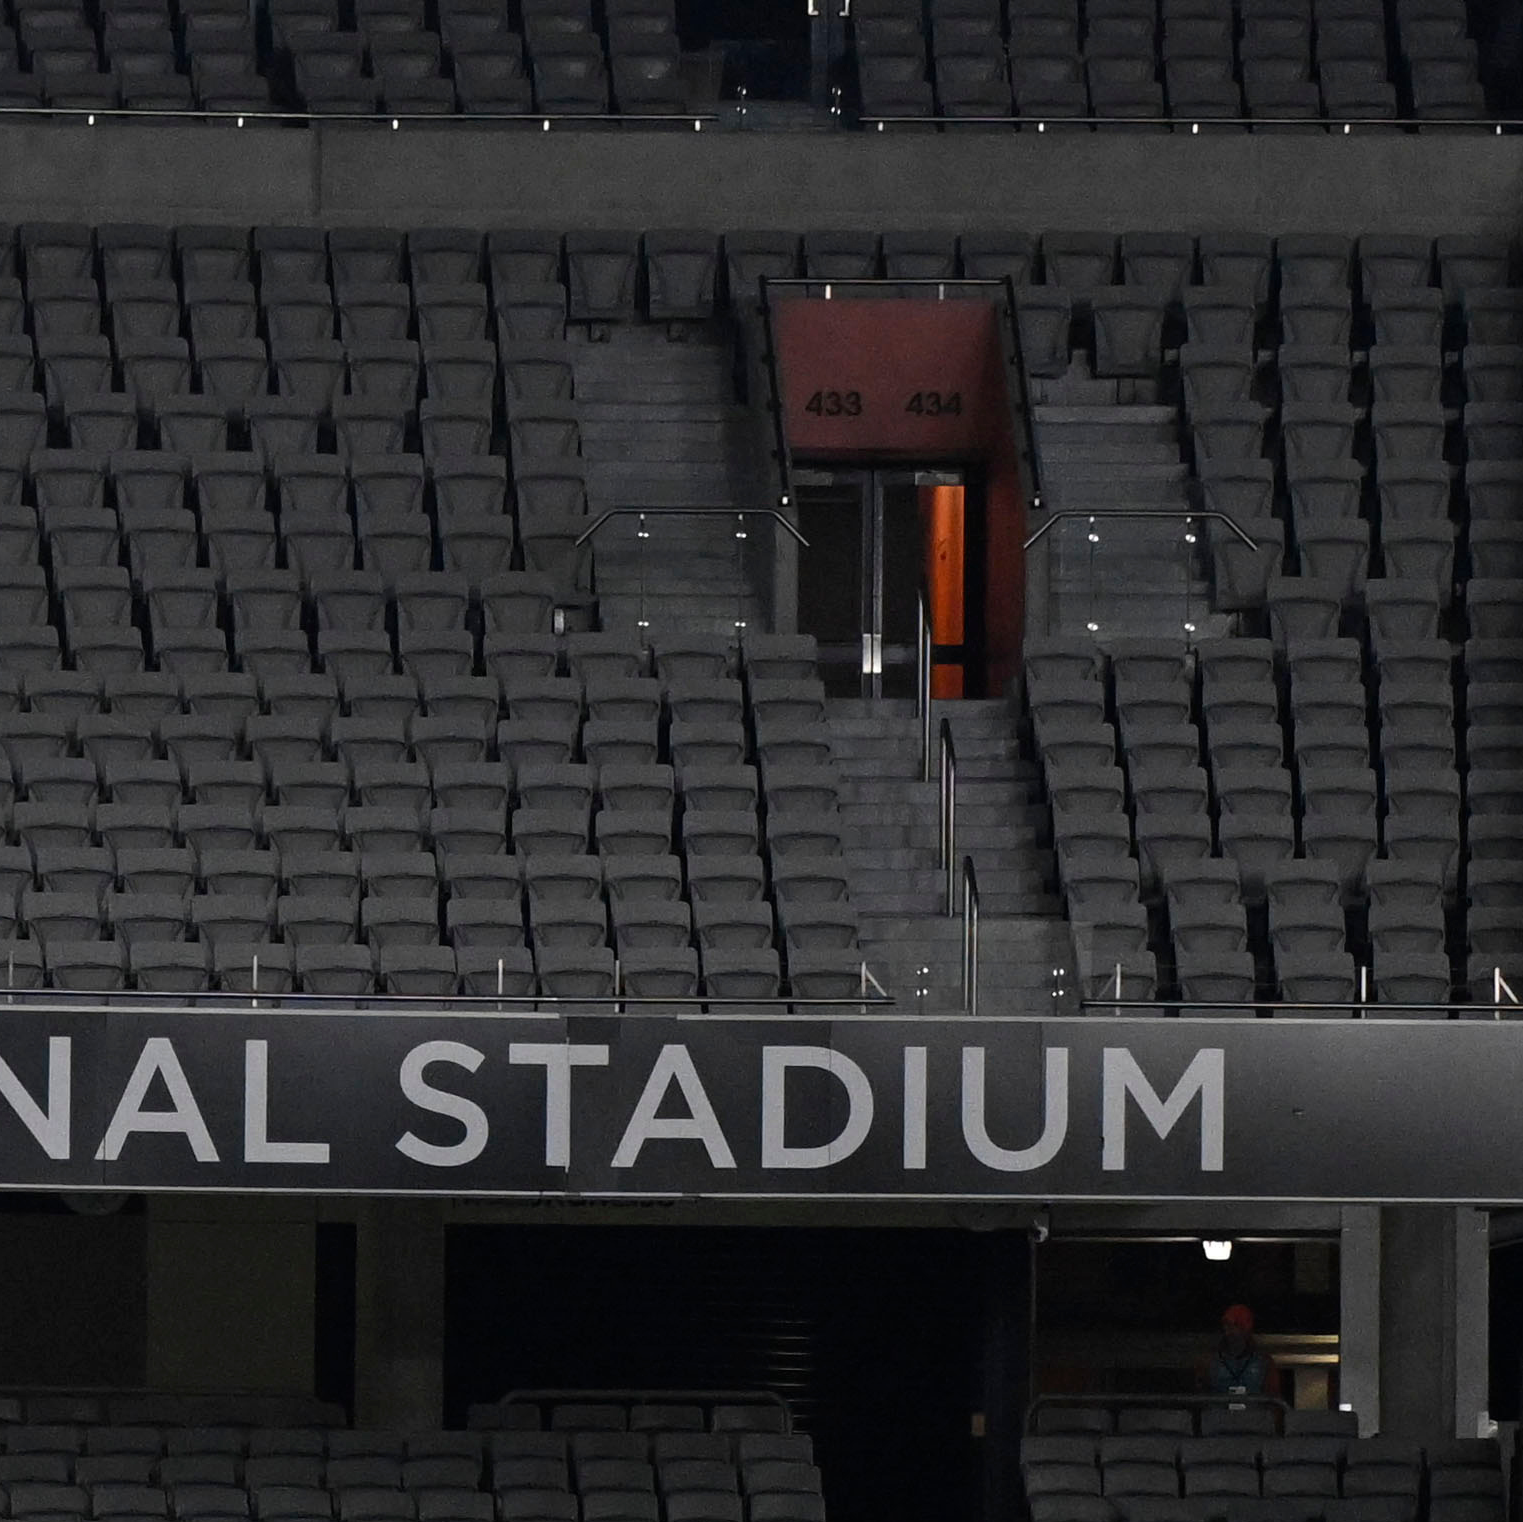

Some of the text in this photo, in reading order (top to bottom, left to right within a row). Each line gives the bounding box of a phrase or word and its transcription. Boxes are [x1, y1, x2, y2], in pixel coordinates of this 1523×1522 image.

[805, 391, 962, 417] 433 434
[394, 1040, 1226, 1172] STADIUM
